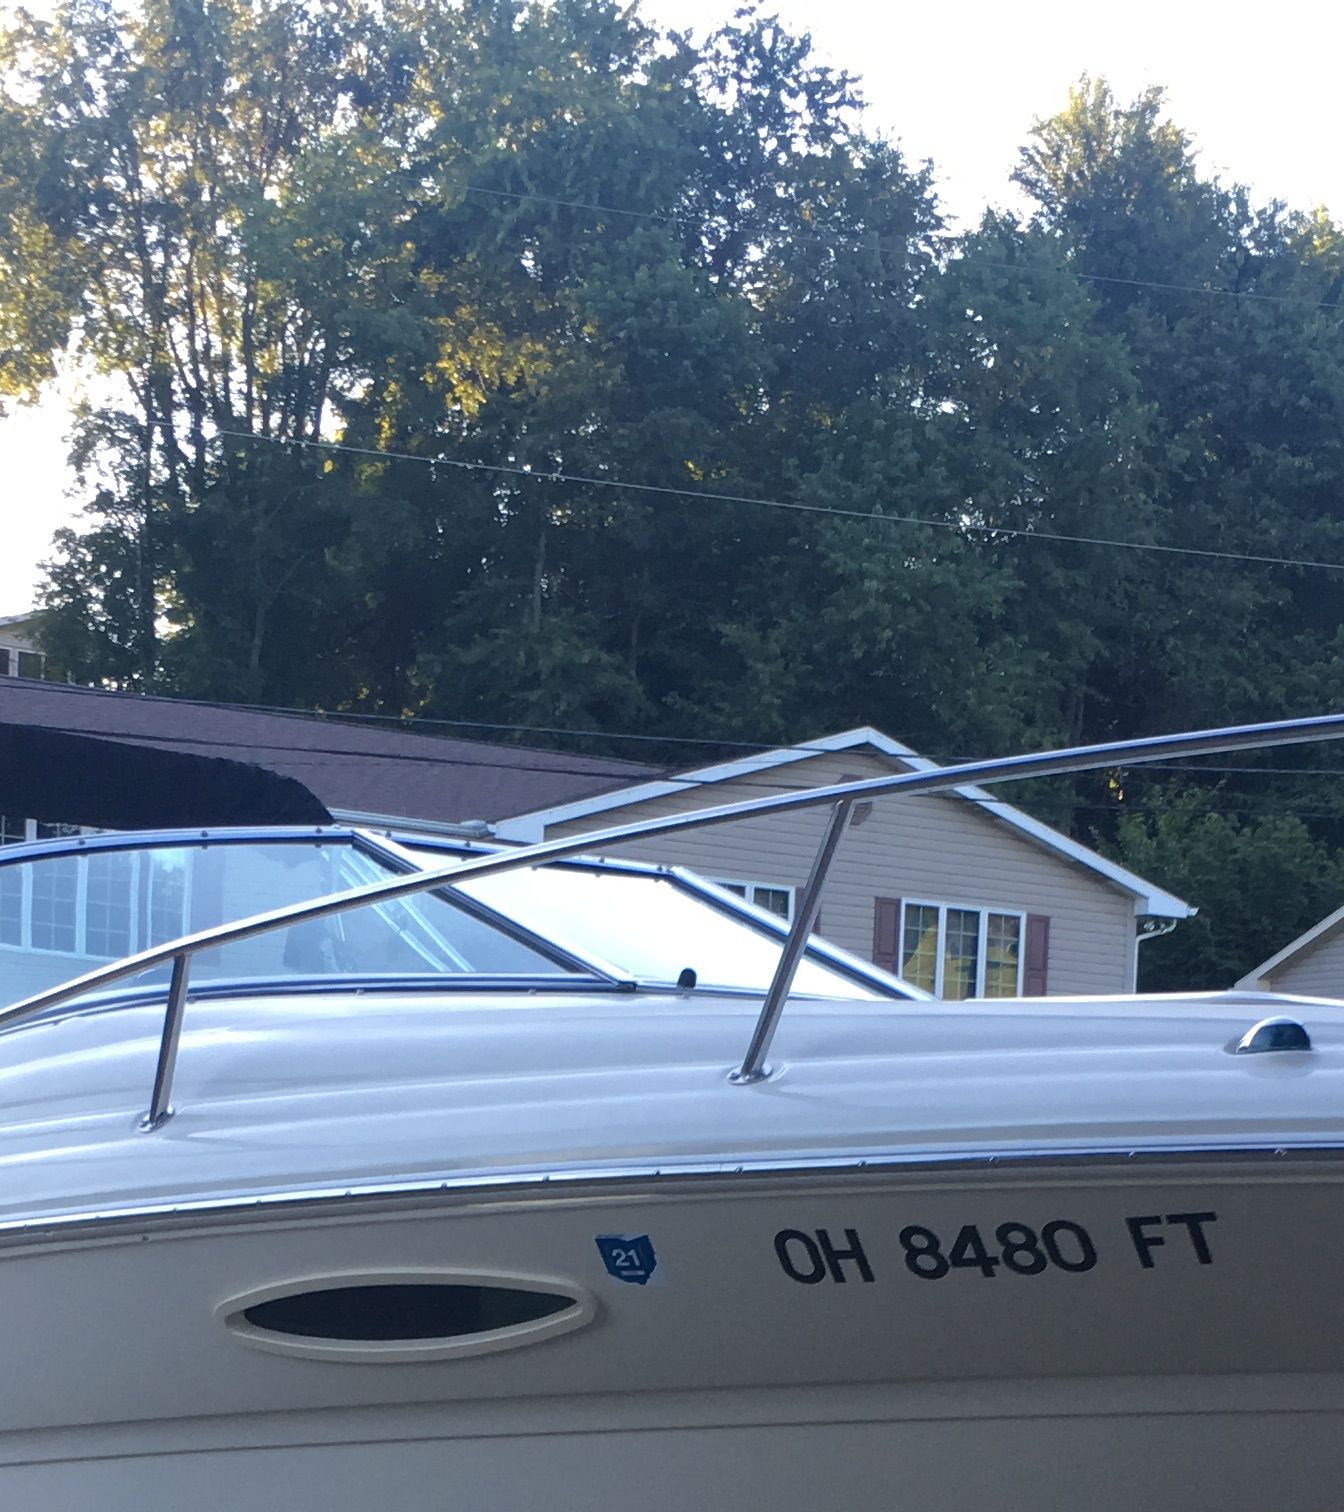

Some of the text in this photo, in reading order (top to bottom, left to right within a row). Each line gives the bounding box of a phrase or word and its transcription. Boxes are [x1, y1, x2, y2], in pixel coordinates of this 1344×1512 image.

[611, 1248, 641, 1267] 21
[774, 1211, 1217, 1284] OH 8480 FT
